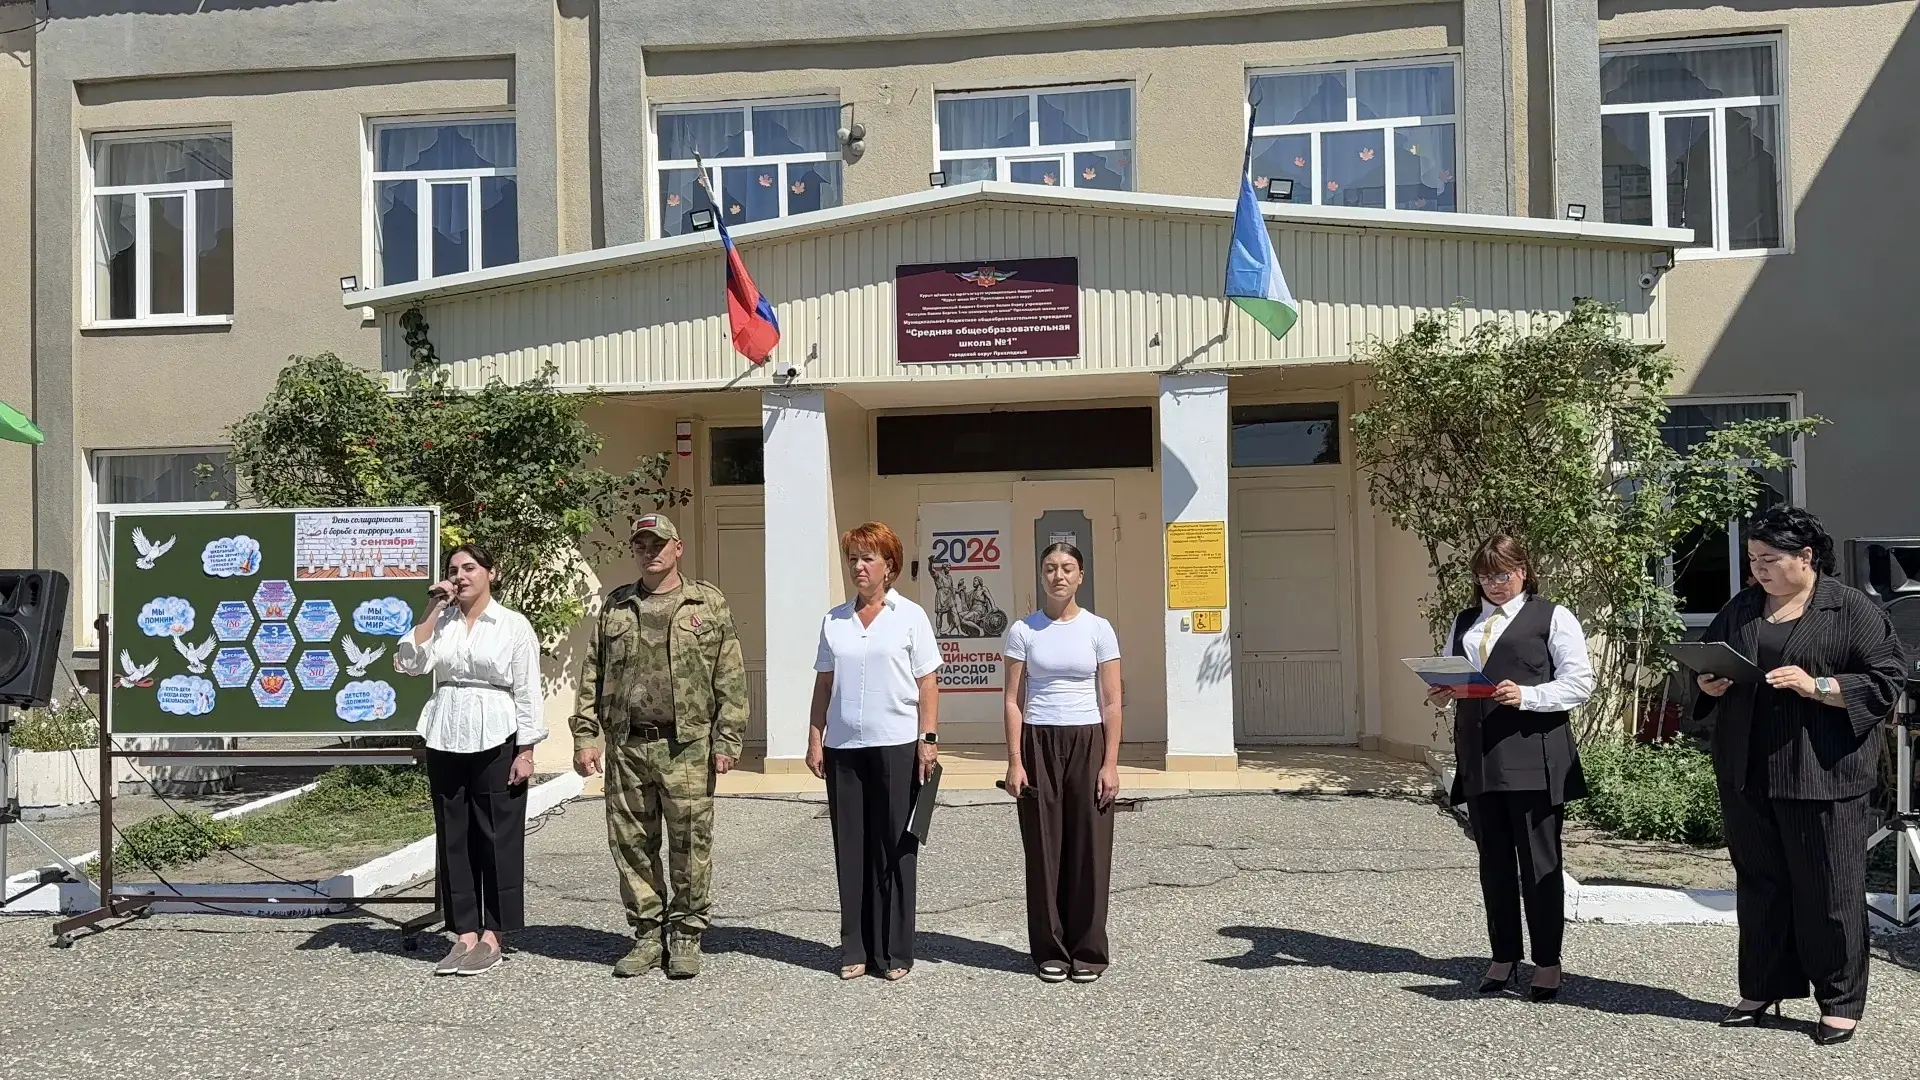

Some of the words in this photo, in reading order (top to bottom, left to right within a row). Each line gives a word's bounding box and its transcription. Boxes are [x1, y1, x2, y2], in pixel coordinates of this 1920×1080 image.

[977, 315, 1038, 323] общеобразовательное
[905, 328, 953, 338] “Средняя
[955, 324, 1071, 336] общеобразовательная
[958, 340, 992, 348] школа
[994, 337, 1018, 346] №1”
[993, 349, 1028, 357] Прохладный
[331, 516, 350, 524] День
[350, 515, 404, 525] солидарности
[323, 527, 328, 535] в
[328, 526, 353, 536] борьбе
[358, 527, 412, 537] терроризмом
[350, 537, 357, 546] 3
[360, 537, 416, 548] сентября
[932, 537, 1001, 564] 2026
[151, 608, 165, 616] МЫ
[367, 607, 382, 615] МЫ
[144, 616, 174, 624] ПОМНИМ
[365, 621, 384, 629] МИР
[271, 626, 279, 638] 3
[937, 642, 960, 652] ОД
[940, 652, 1003, 664] ДИНСТВА
[936, 675, 988, 685] РОССИИ
[344, 691, 371, 699] ДЕТСТВО
